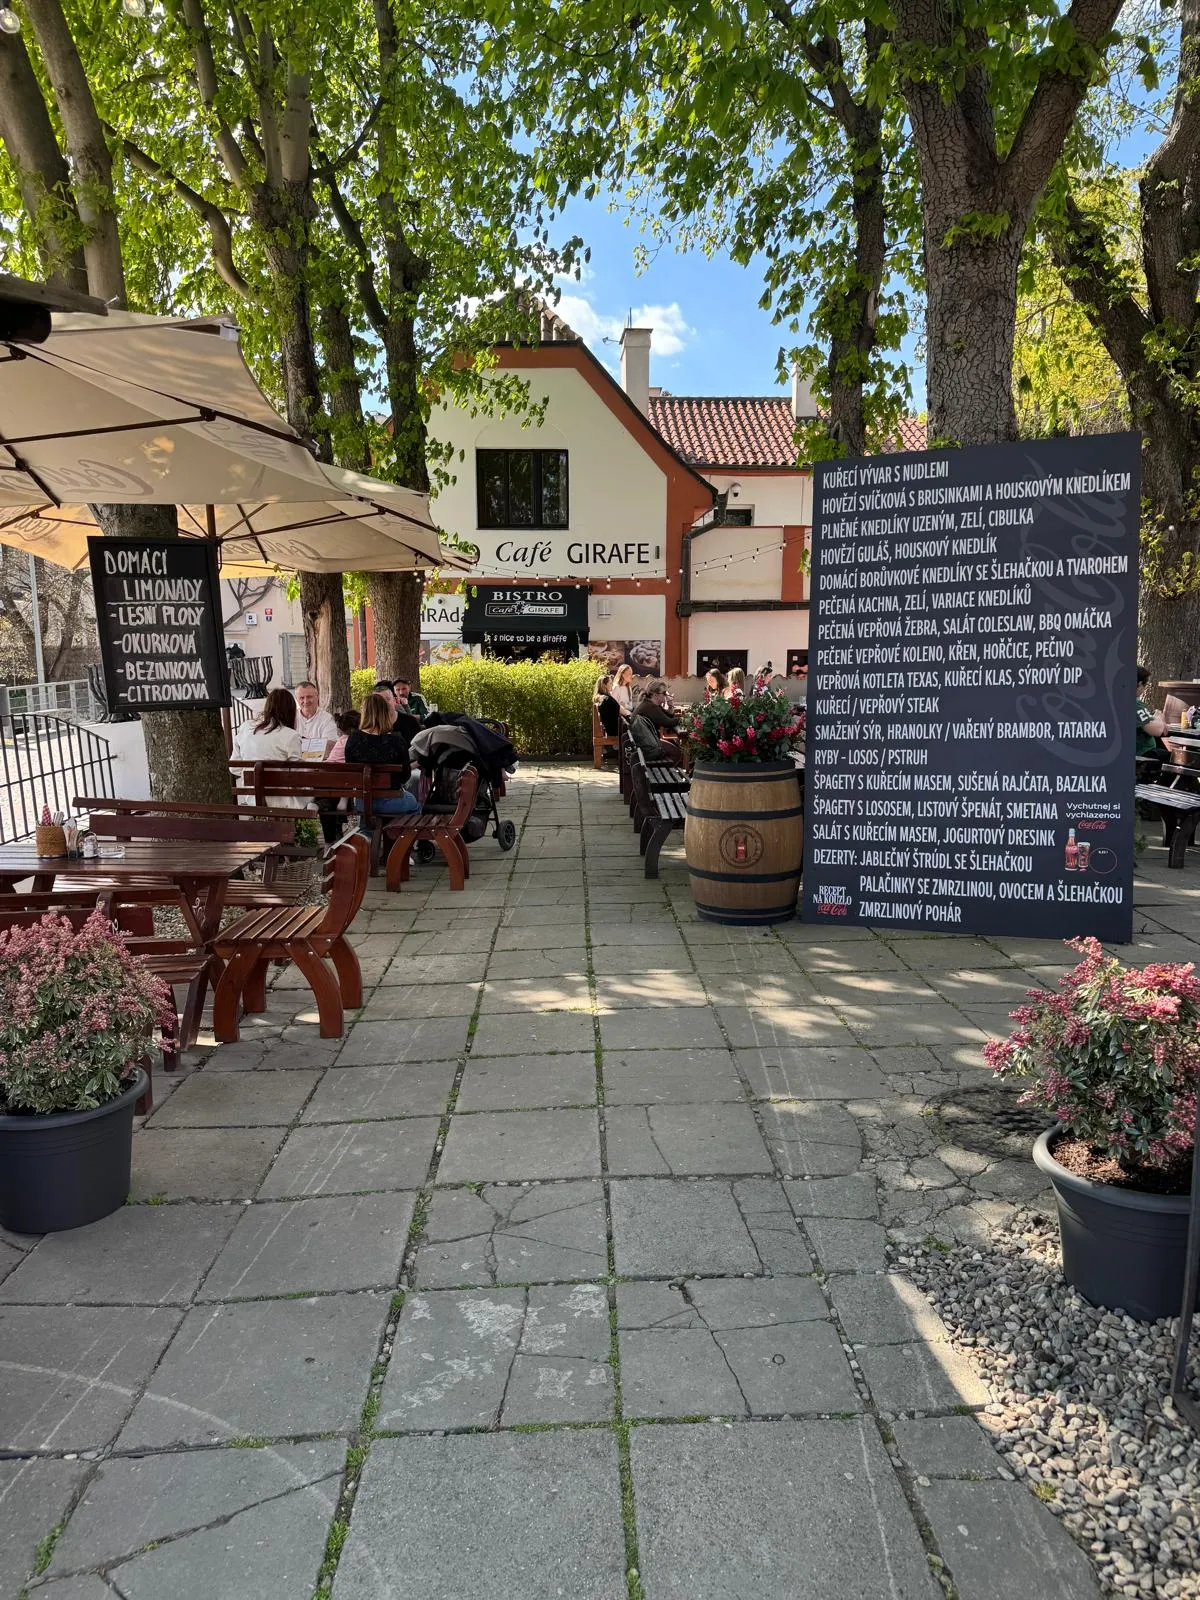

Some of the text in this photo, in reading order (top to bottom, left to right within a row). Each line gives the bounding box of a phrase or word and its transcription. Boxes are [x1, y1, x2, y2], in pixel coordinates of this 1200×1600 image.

[822, 460, 948, 489] KUŘECÍ VÝVAR S NUDLEMI
[822, 469, 1130, 514] HOVĚZÍ SVÍČKOVÁ S BRUSINKAMI A HOUSKOVÝM KNEDLÍKEM
[821, 506, 1034, 540] PLNĚNÉ KNEDLÍKY UZENÝM, ZELÍ, CIBULKA
[104, 548, 168, 575] DOMÁCÍ
[495, 541, 552, 567] Café
[566, 542, 650, 564] GIRAFE
[820, 532, 997, 565] HOVĚZÍ GULÁŠ, HOUSKOVÝ KNEDLÍK
[819, 555, 1128, 590] DOMÁCÍ BORŮVKOVÉ KNEDLÍKY SE ŠLEHAČKOU A TVAROHEM
[123, 577, 203, 602] LIMONÁDY
[492, 591, 563, 601] BISTRO
[818, 582, 1031, 615] PEČENÁ KACHNA, ZELÍ, VARIACE KNEDLÍKŮ
[162, 605, 205, 626] PLODY
[527, 605, 560, 614] GIRAFE
[818, 606, 1112, 640] PEČENÁ VEPŘOVÁ ŽEBRA, SALÁT COLESLAW, BBQ OMÁČKA
[499, 633, 514, 642] nice
[516, 633, 524, 642] to
[526, 633, 535, 642] be
[542, 633, 567, 644] giraffe
[817, 635, 1074, 665] PEČENÉ VEPŘOVÉ KOLENO, KŘEN, HOŘČICE, PEČIVO
[816, 662, 1082, 690] VEPŘOVÁ KOTLETA TEXAS, KUŘECÍ KLAS, SÝROVÝ DIP
[815, 693, 939, 717] KUŘECÍ / VEPŘOVÝ STEAK
[815, 717, 1107, 742] SMAŽENÝ SÝR, HRANOLKY / VAŘENÝ BRAMBOR, TATARKA
[814, 749, 839, 765] RYBY
[848, 749, 879, 765] LOSOS
[880, 747, 886, 768] /
[888, 748, 928, 765] PSTRUH
[813, 769, 1107, 795] ŠPAGETY S KUŘECÍM MASEM, SUŠENÁ RAJČATA, BAZALKA
[813, 794, 1058, 821] ŠPAGETY S LOSOSEM, LISTOVÝ ŠPENÁT, SMETANA
[1066, 811, 1121, 819] vychlazenou
[1067, 802, 1111, 811] Vychutnej
[812, 820, 1055, 846] SALÁT S KUŘECÍM MASEM, JOGURTOVÝ DRESINK
[813, 846, 1032, 872] DEZERTY: JABLEČNÝ ŠTRÚDL SE ŠLEHAČKOU
[812, 893, 852, 906] NA KOUZLO
[818, 885, 847, 895] RECEPT
[859, 871, 1123, 904] PALAČINKY SE ZMRZLINOU, OVOCEM A ŠLEHAČKOU
[858, 899, 961, 922] ZMRZLINOVÝ POHÁR
